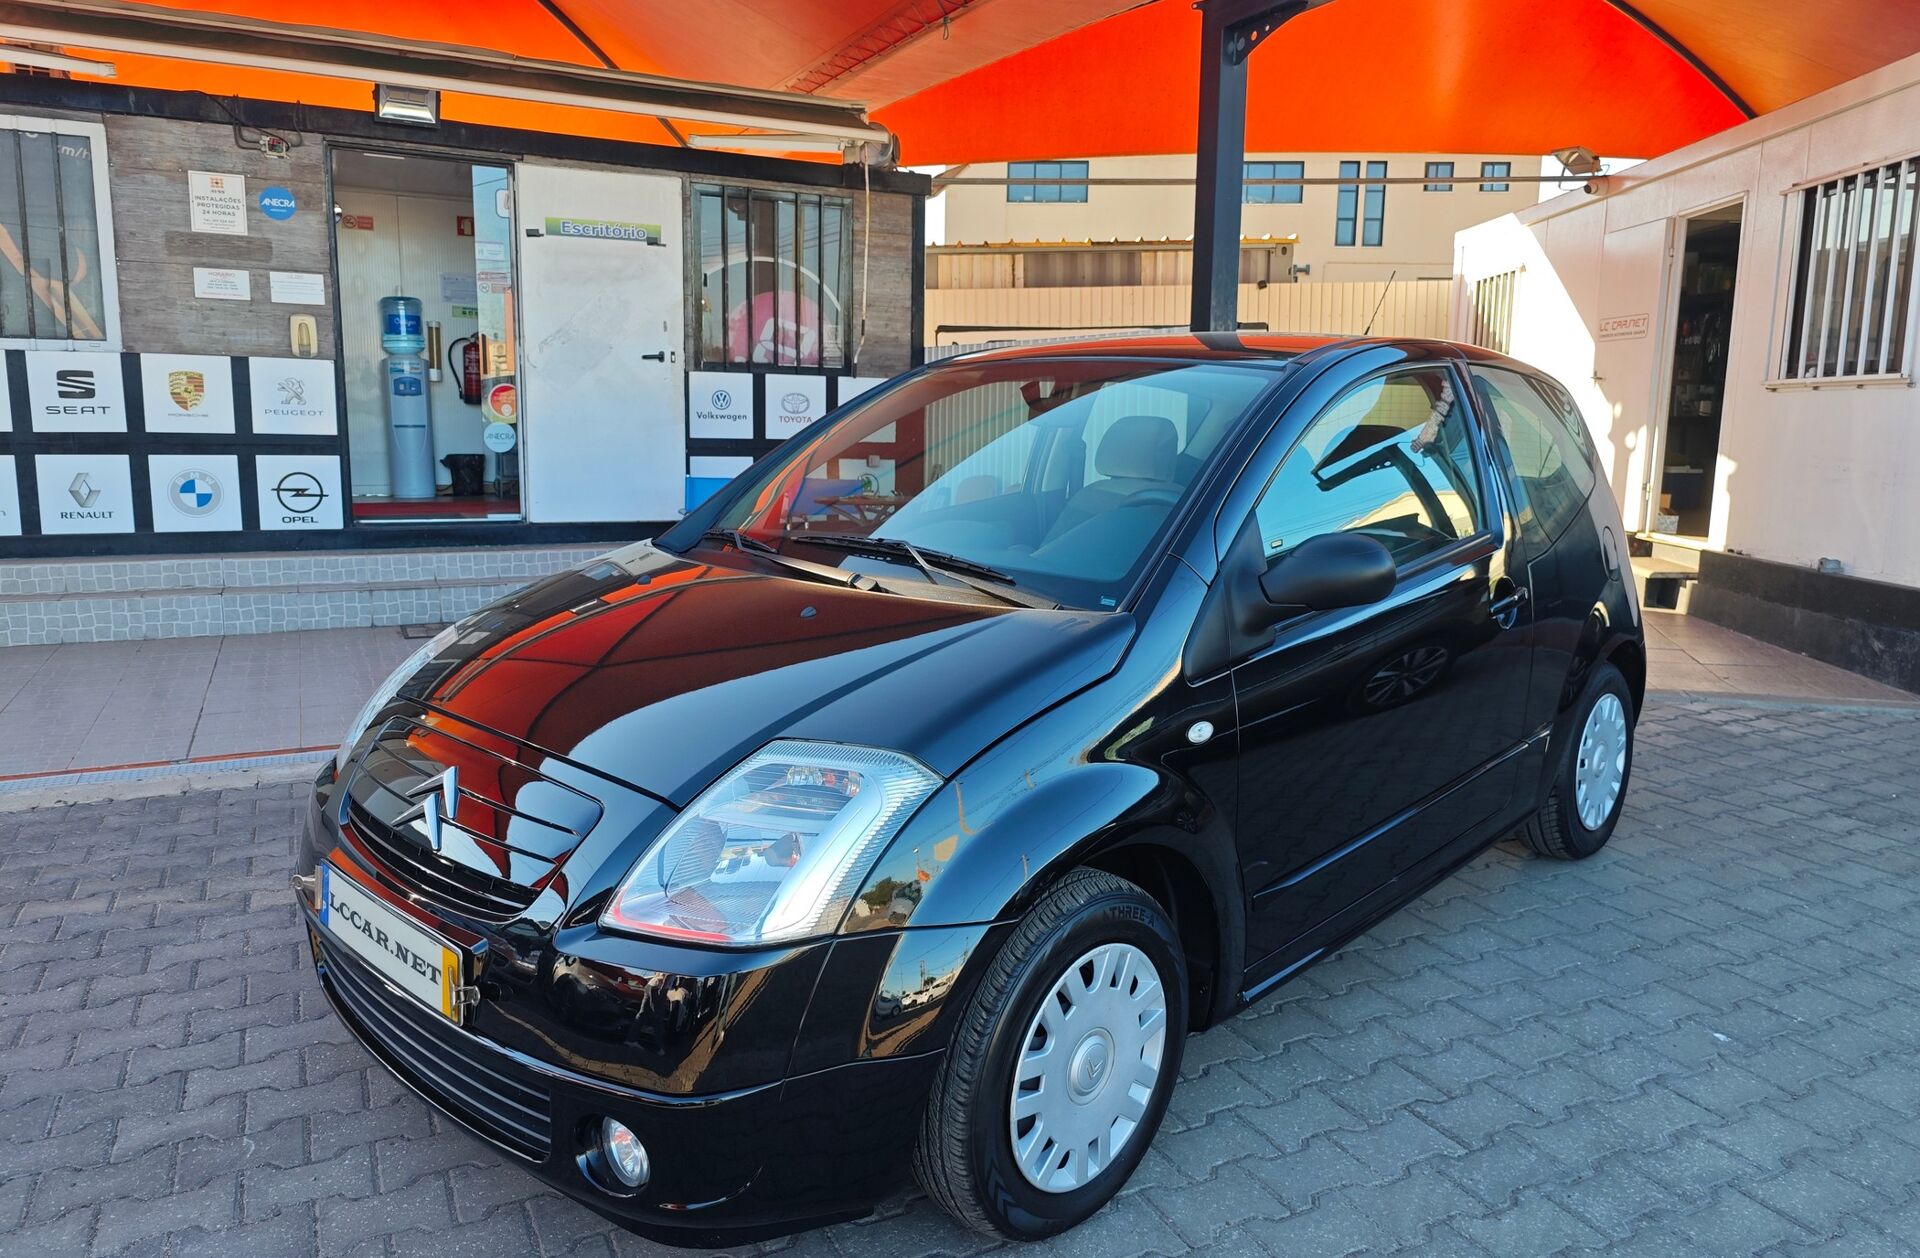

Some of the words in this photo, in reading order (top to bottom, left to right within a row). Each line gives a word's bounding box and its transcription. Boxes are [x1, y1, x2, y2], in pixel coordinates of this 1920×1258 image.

[261, 198, 295, 208] ANECRA
[561, 221, 647, 239] Escritório
[45, 406, 111, 415] SEAT
[696, 411, 748, 421] Volkswagen
[779, 415, 813, 424] TOYOTA
[60, 511, 114, 520] RENAULT
[281, 516, 319, 524] OPEL
[329, 892, 442, 985] LCCAR.NET
